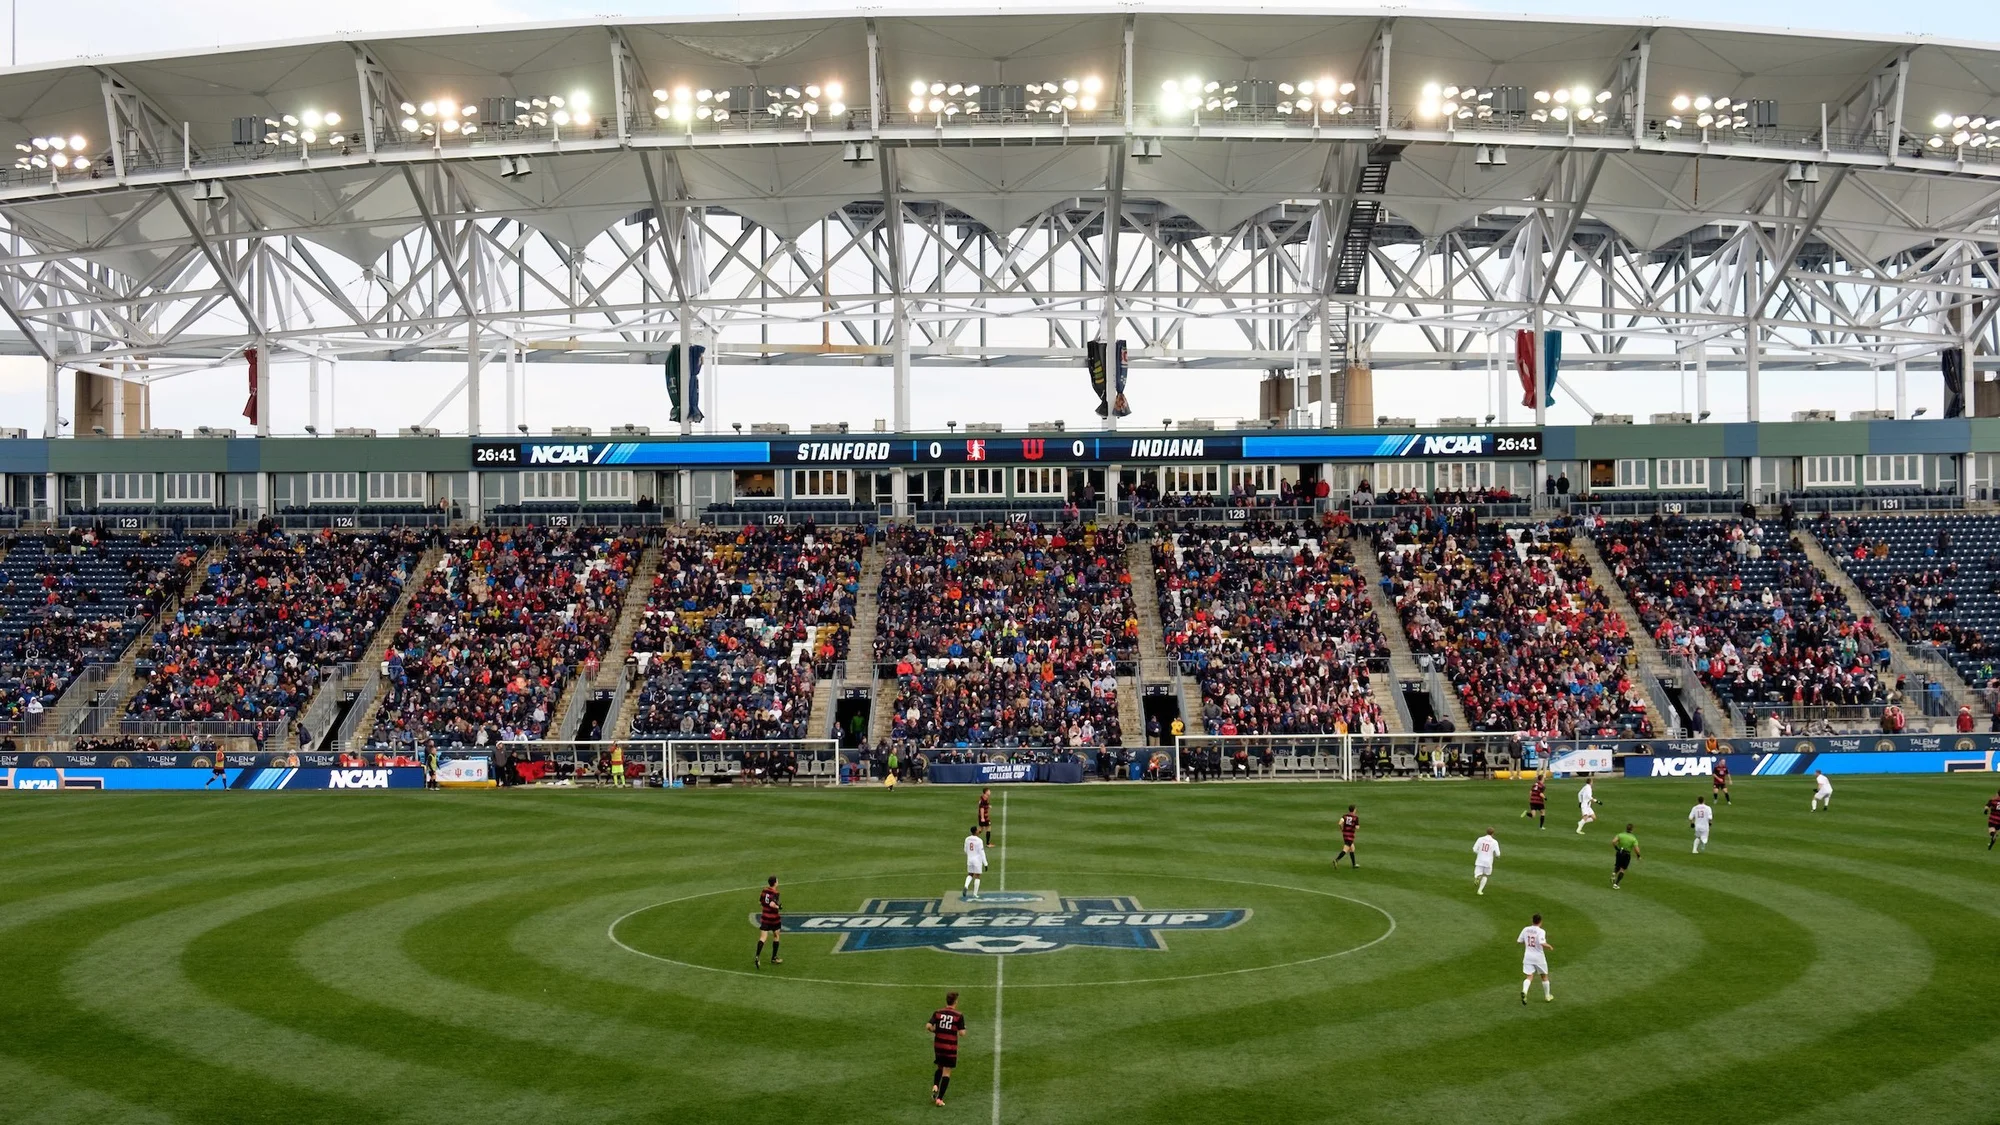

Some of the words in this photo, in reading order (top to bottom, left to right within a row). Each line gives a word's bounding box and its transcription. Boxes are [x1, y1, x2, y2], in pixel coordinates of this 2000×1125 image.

[477, 448, 516, 462] 26:41
[530, 445, 589, 464] NCAA
[797, 442, 890, 461] STANFORD
[929, 441, 942, 459] 0
[1072, 440, 1085, 457] 0
[1131, 439, 1204, 457] INDIANA
[1423, 435, 1482, 455] NCAA
[1497, 437, 1537, 451] 26:41
[1664, 503, 1682, 513] 130
[1882, 499, 1898, 509] 131
[1010, 513, 1027, 523] 127
[1228, 509, 1245, 519] 128
[120, 518, 138, 528] 123
[336, 517, 353, 527] 124
[550, 516, 568, 526] 125
[768, 514, 785, 525] 126
[1651, 756, 1713, 777] NCAA
[329, 769, 389, 788] NCAA
[989, 772, 1013, 780] COLLEGE
[1014, 771, 1025, 779] CUP
[1481, 842, 1490, 852] 10
[799, 915, 1073, 928] COLLEGE
[1081, 913, 1209, 926] CUP
[1527, 935, 1536, 947] 12
[939, 1014, 953, 1030] 22
